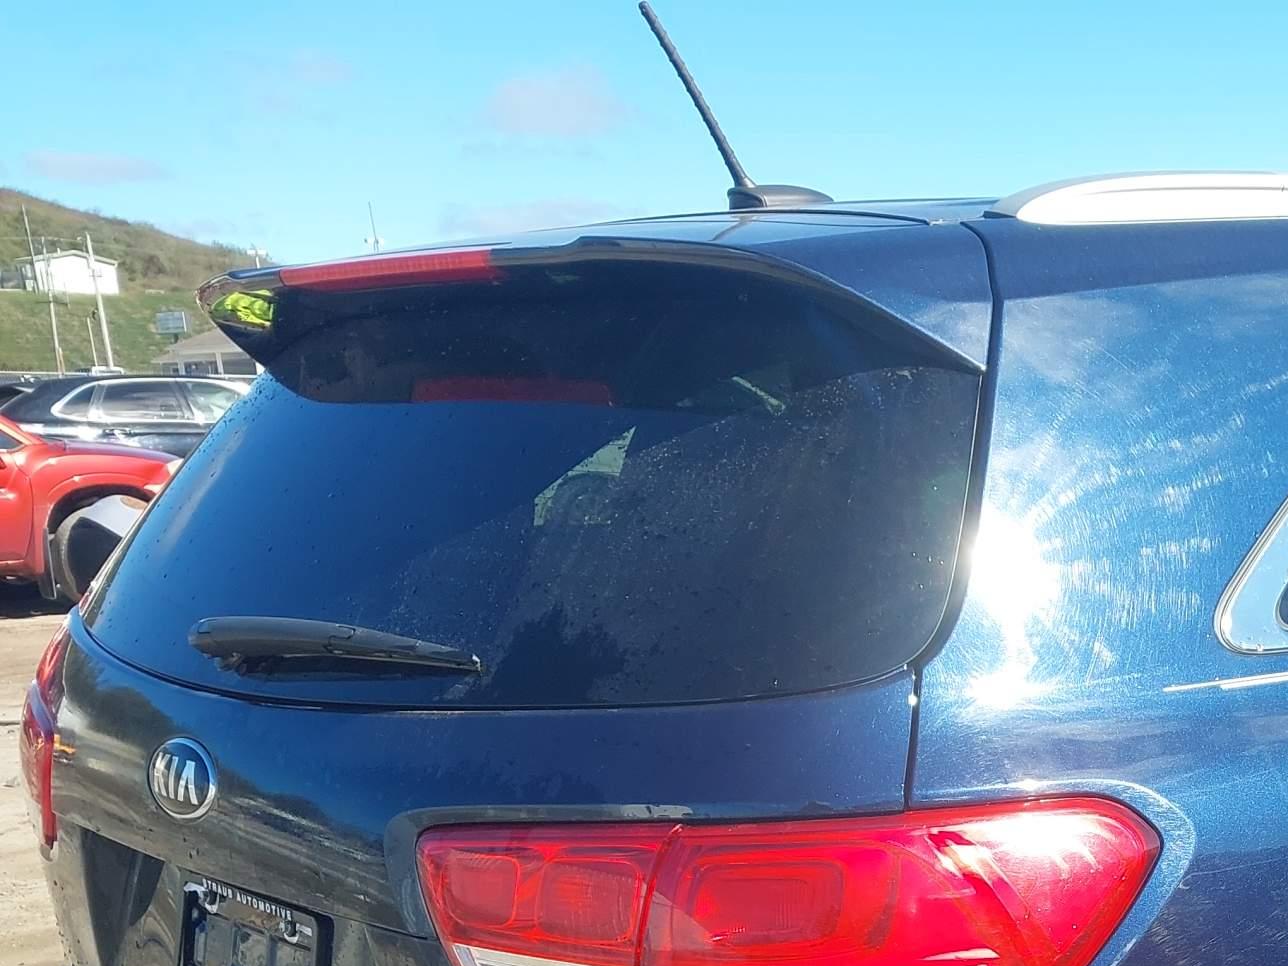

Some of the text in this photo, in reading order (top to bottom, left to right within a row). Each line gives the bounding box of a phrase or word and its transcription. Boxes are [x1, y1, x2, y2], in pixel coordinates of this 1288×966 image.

[153, 751, 199, 806] KIA
[202, 877, 292, 922] STRAUB AUTOMOTIVE
